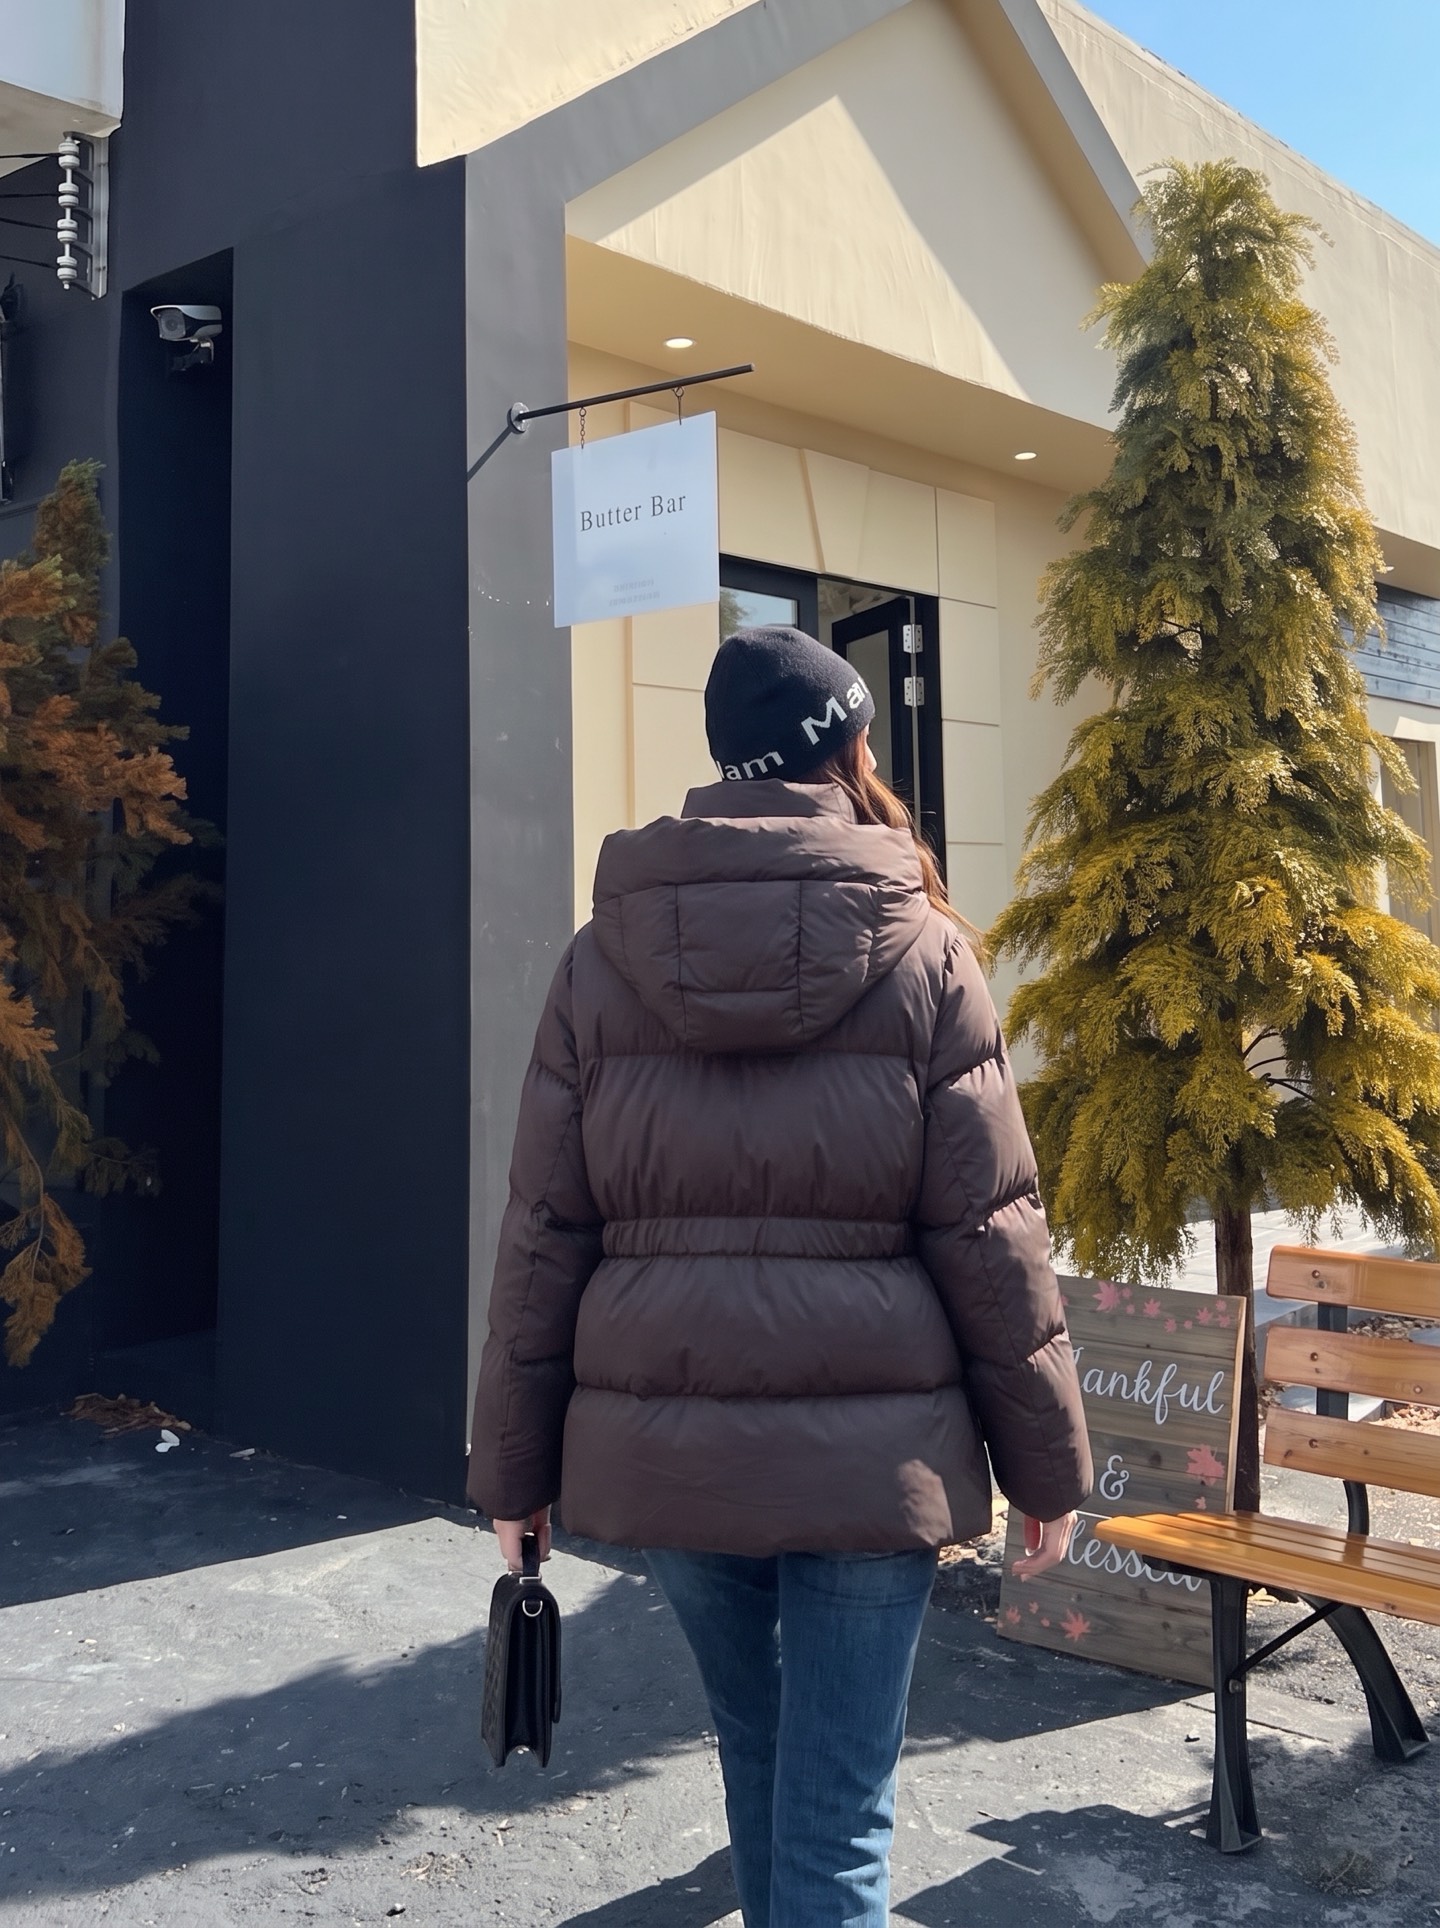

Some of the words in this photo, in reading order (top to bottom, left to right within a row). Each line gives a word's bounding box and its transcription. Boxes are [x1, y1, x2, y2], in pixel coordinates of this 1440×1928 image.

[580, 505, 642, 532] Butter
[651, 495, 686, 517] Bar
[1073, 1346, 1225, 1425] ankful
[1099, 1454, 1130, 1501] &
[1067, 1519, 1203, 1592] less
